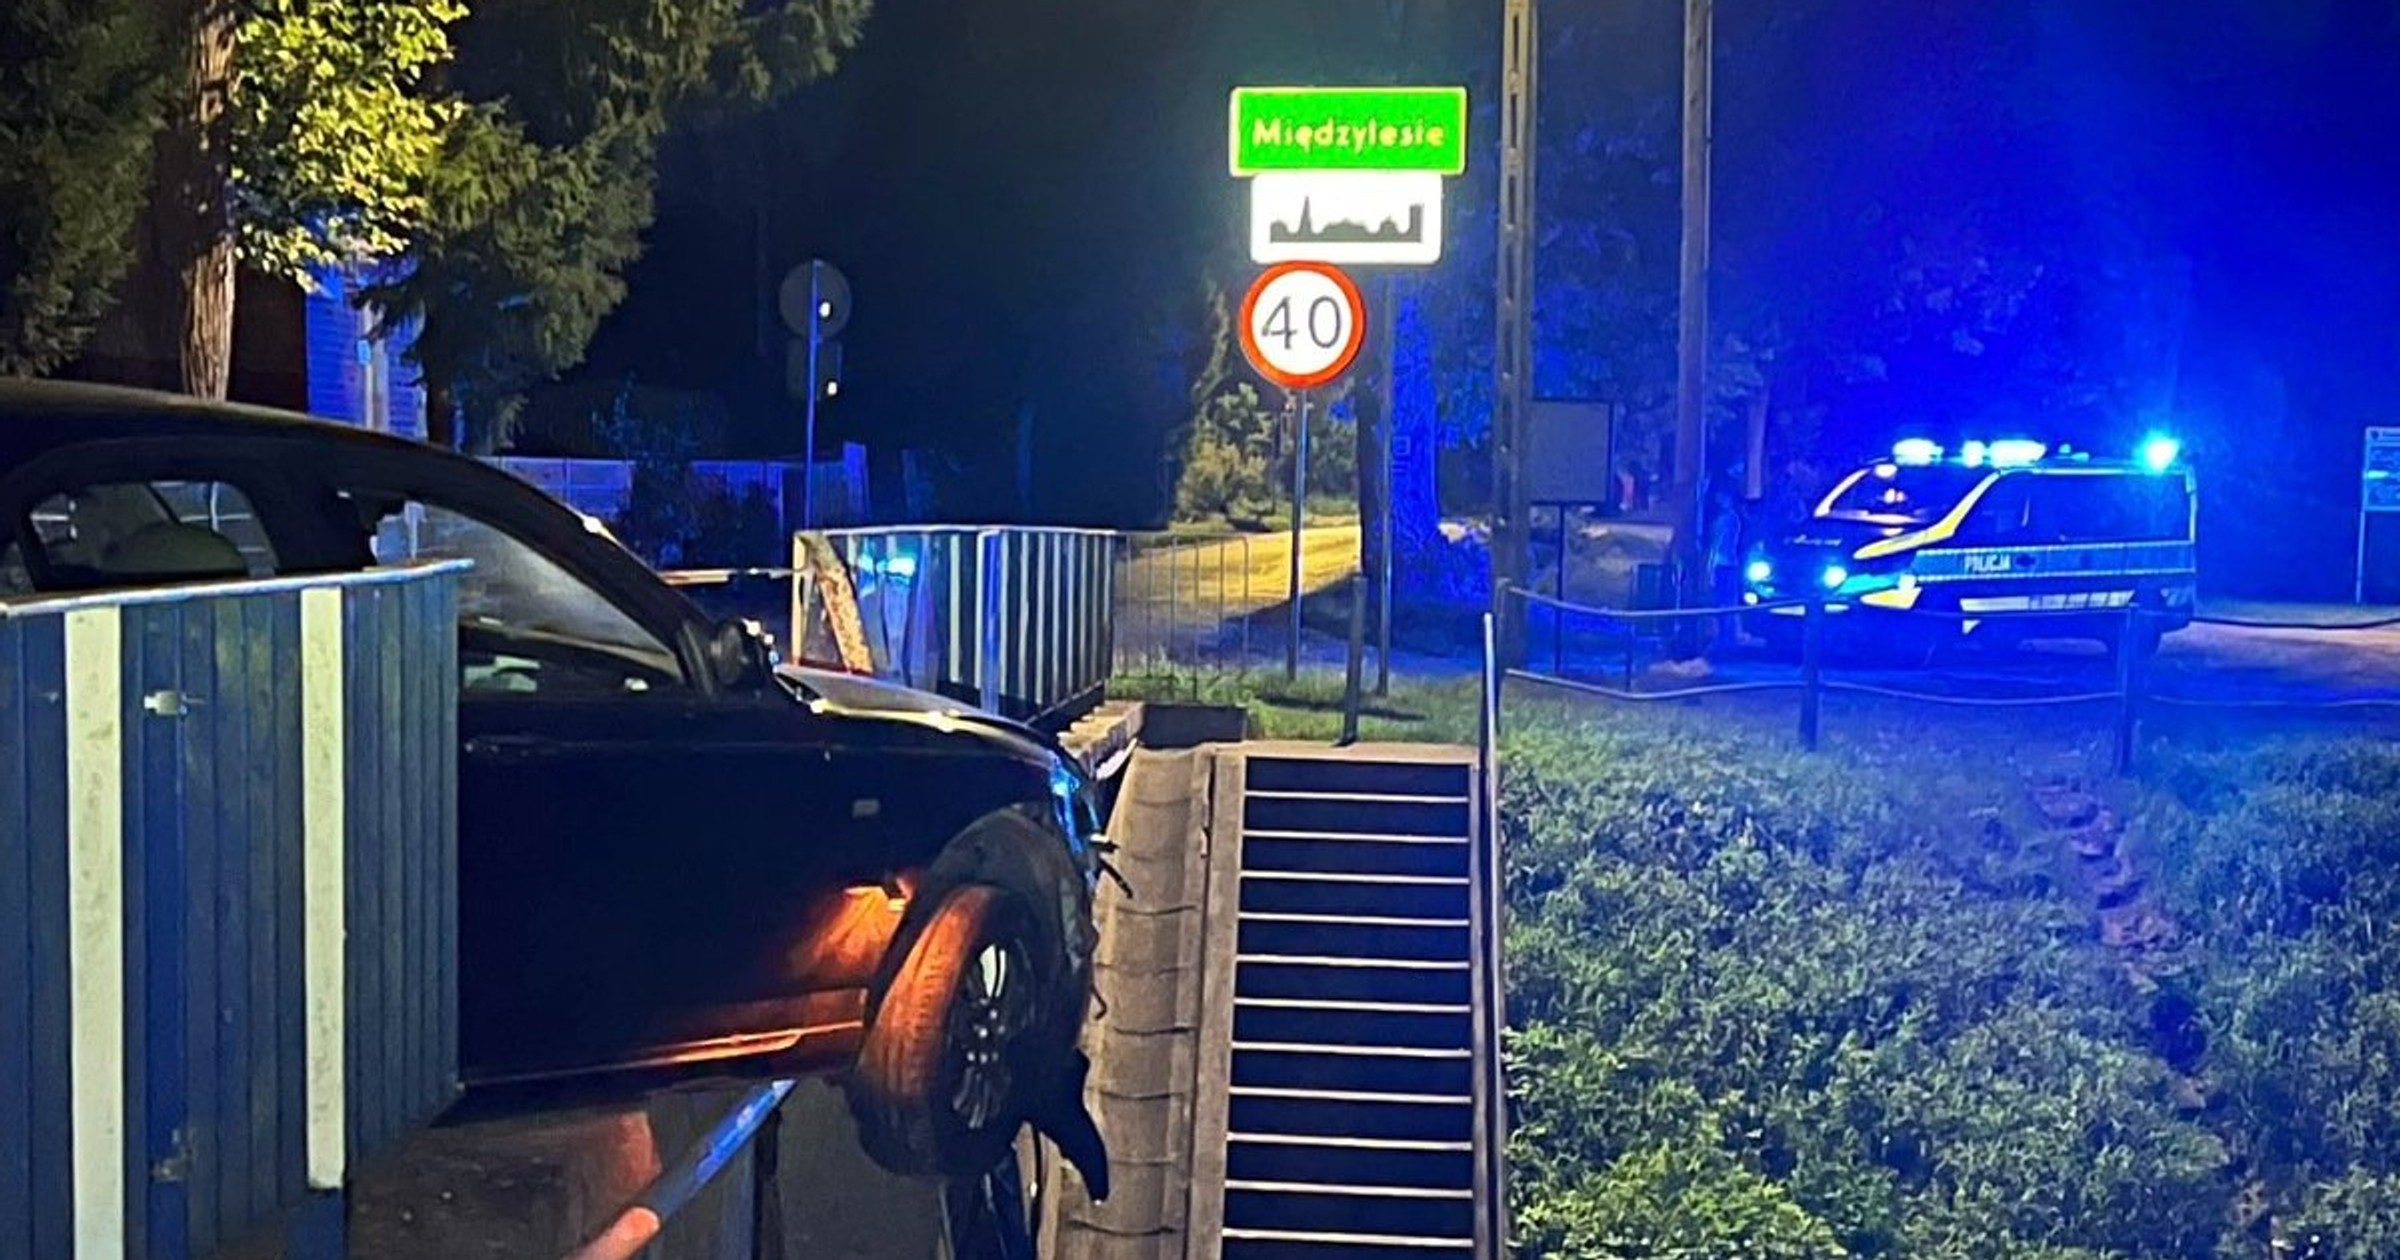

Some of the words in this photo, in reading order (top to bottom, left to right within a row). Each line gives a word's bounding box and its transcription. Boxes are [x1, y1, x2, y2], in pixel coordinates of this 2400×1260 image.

[1252, 117, 1445, 155] Międzylesie
[1262, 295, 1342, 350] 40
[1963, 553, 2011, 573] POLICJA
